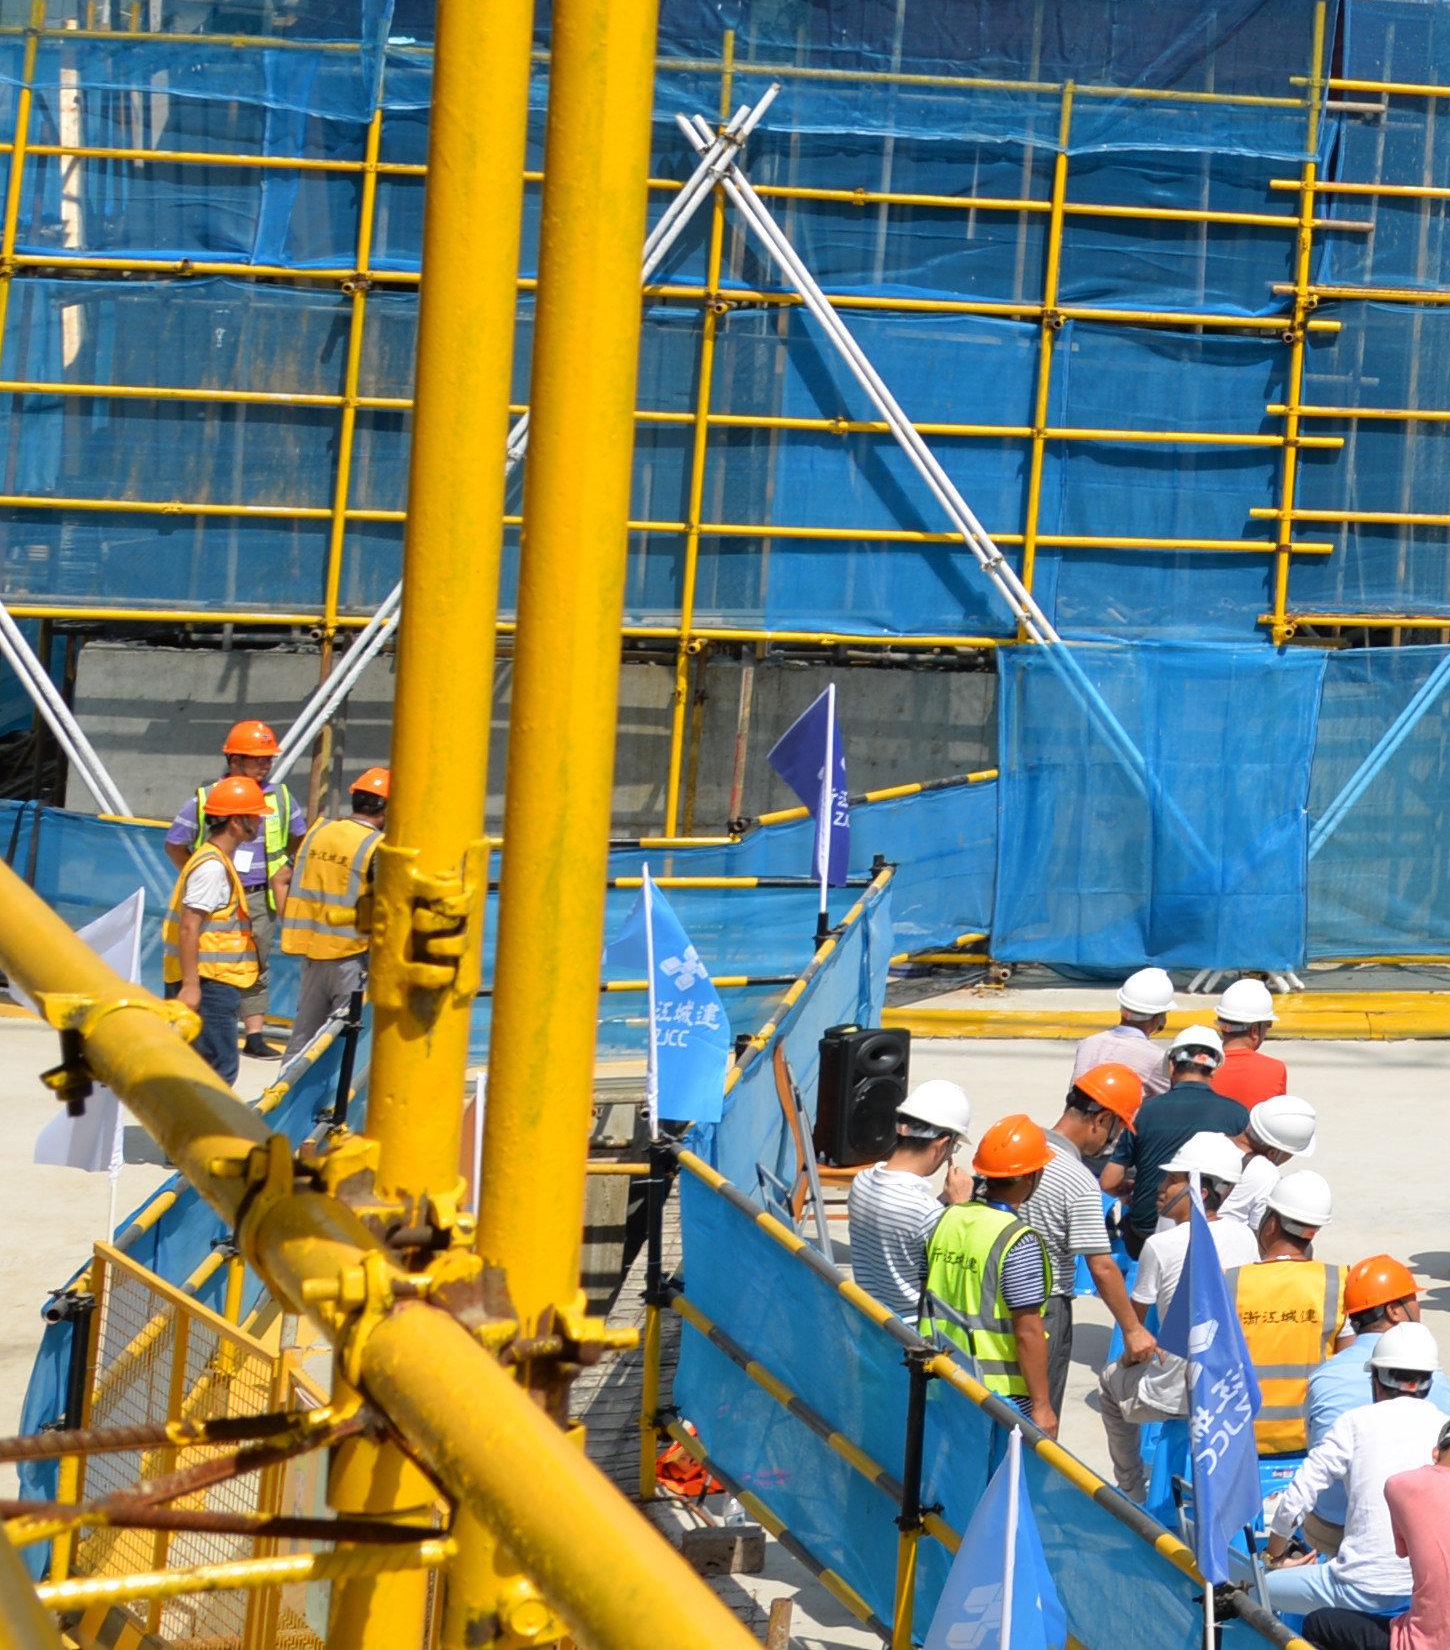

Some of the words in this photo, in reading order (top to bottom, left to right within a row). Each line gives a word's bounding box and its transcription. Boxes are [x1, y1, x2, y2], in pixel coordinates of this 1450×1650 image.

[655, 999, 720, 1030] 江城建
[1242, 1310, 1318, 1325] 浙江城建
